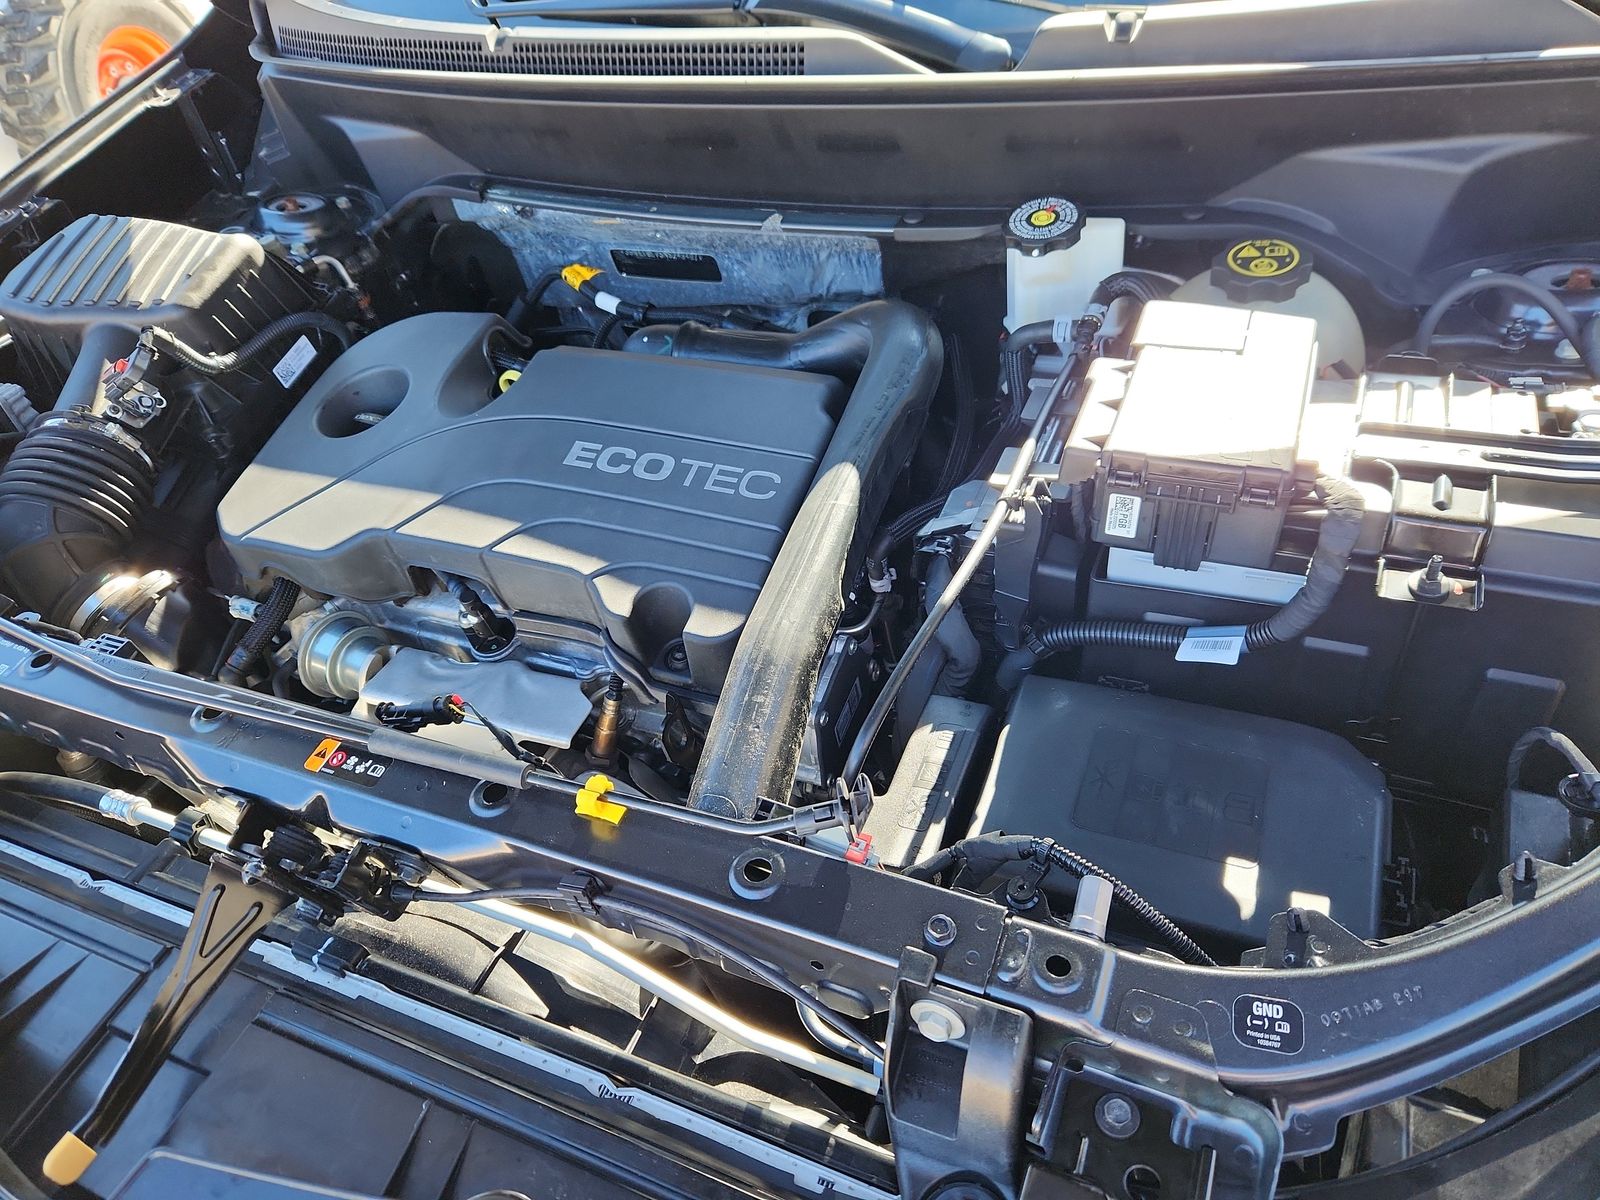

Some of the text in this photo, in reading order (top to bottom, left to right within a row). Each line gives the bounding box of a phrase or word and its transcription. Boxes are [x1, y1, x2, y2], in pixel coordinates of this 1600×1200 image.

[562, 440, 782, 500] ECOTEC
[1118, 513, 1128, 528] PGB
[1252, 1001, 1284, 1019] GND
[1246, 1029, 1264, 1039] Printed
[1269, 1033, 1281, 1042] USA
